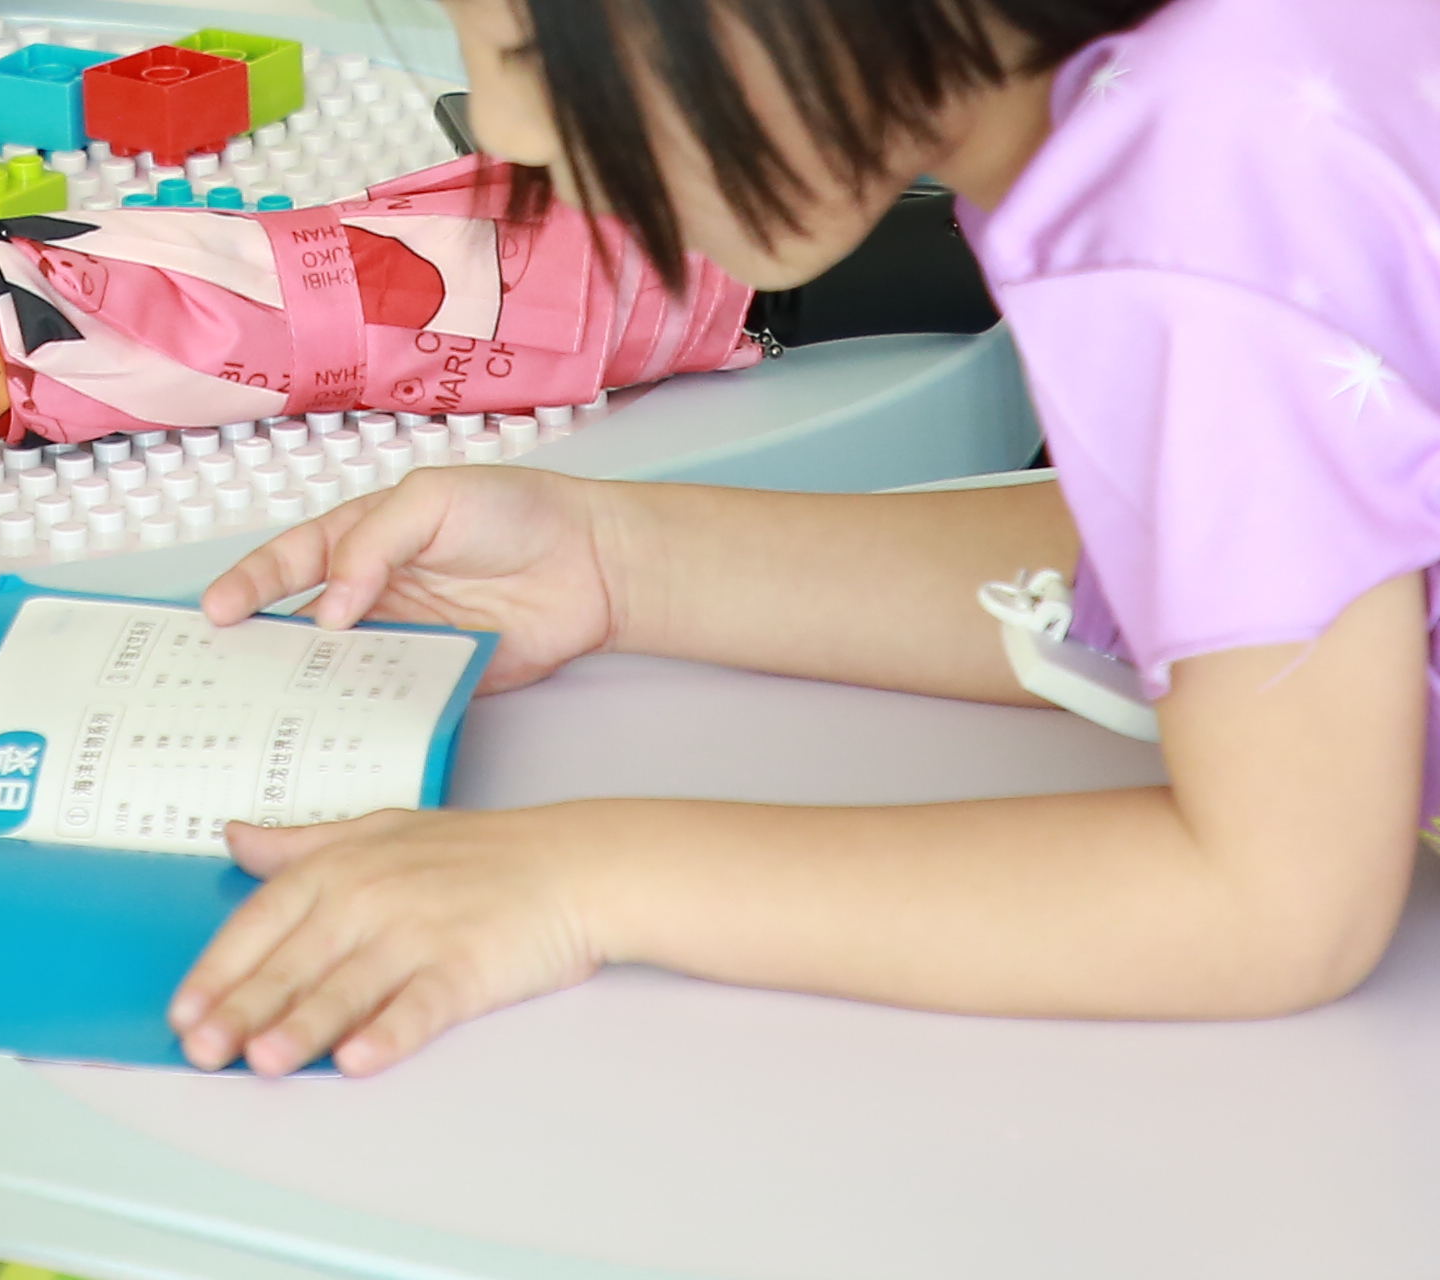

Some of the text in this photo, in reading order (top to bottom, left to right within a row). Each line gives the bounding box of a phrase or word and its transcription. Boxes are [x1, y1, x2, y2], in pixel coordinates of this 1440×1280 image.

[70, 712, 113, 796] 海洋生物系列
[263, 717, 304, 804] 恐龙世界系列
